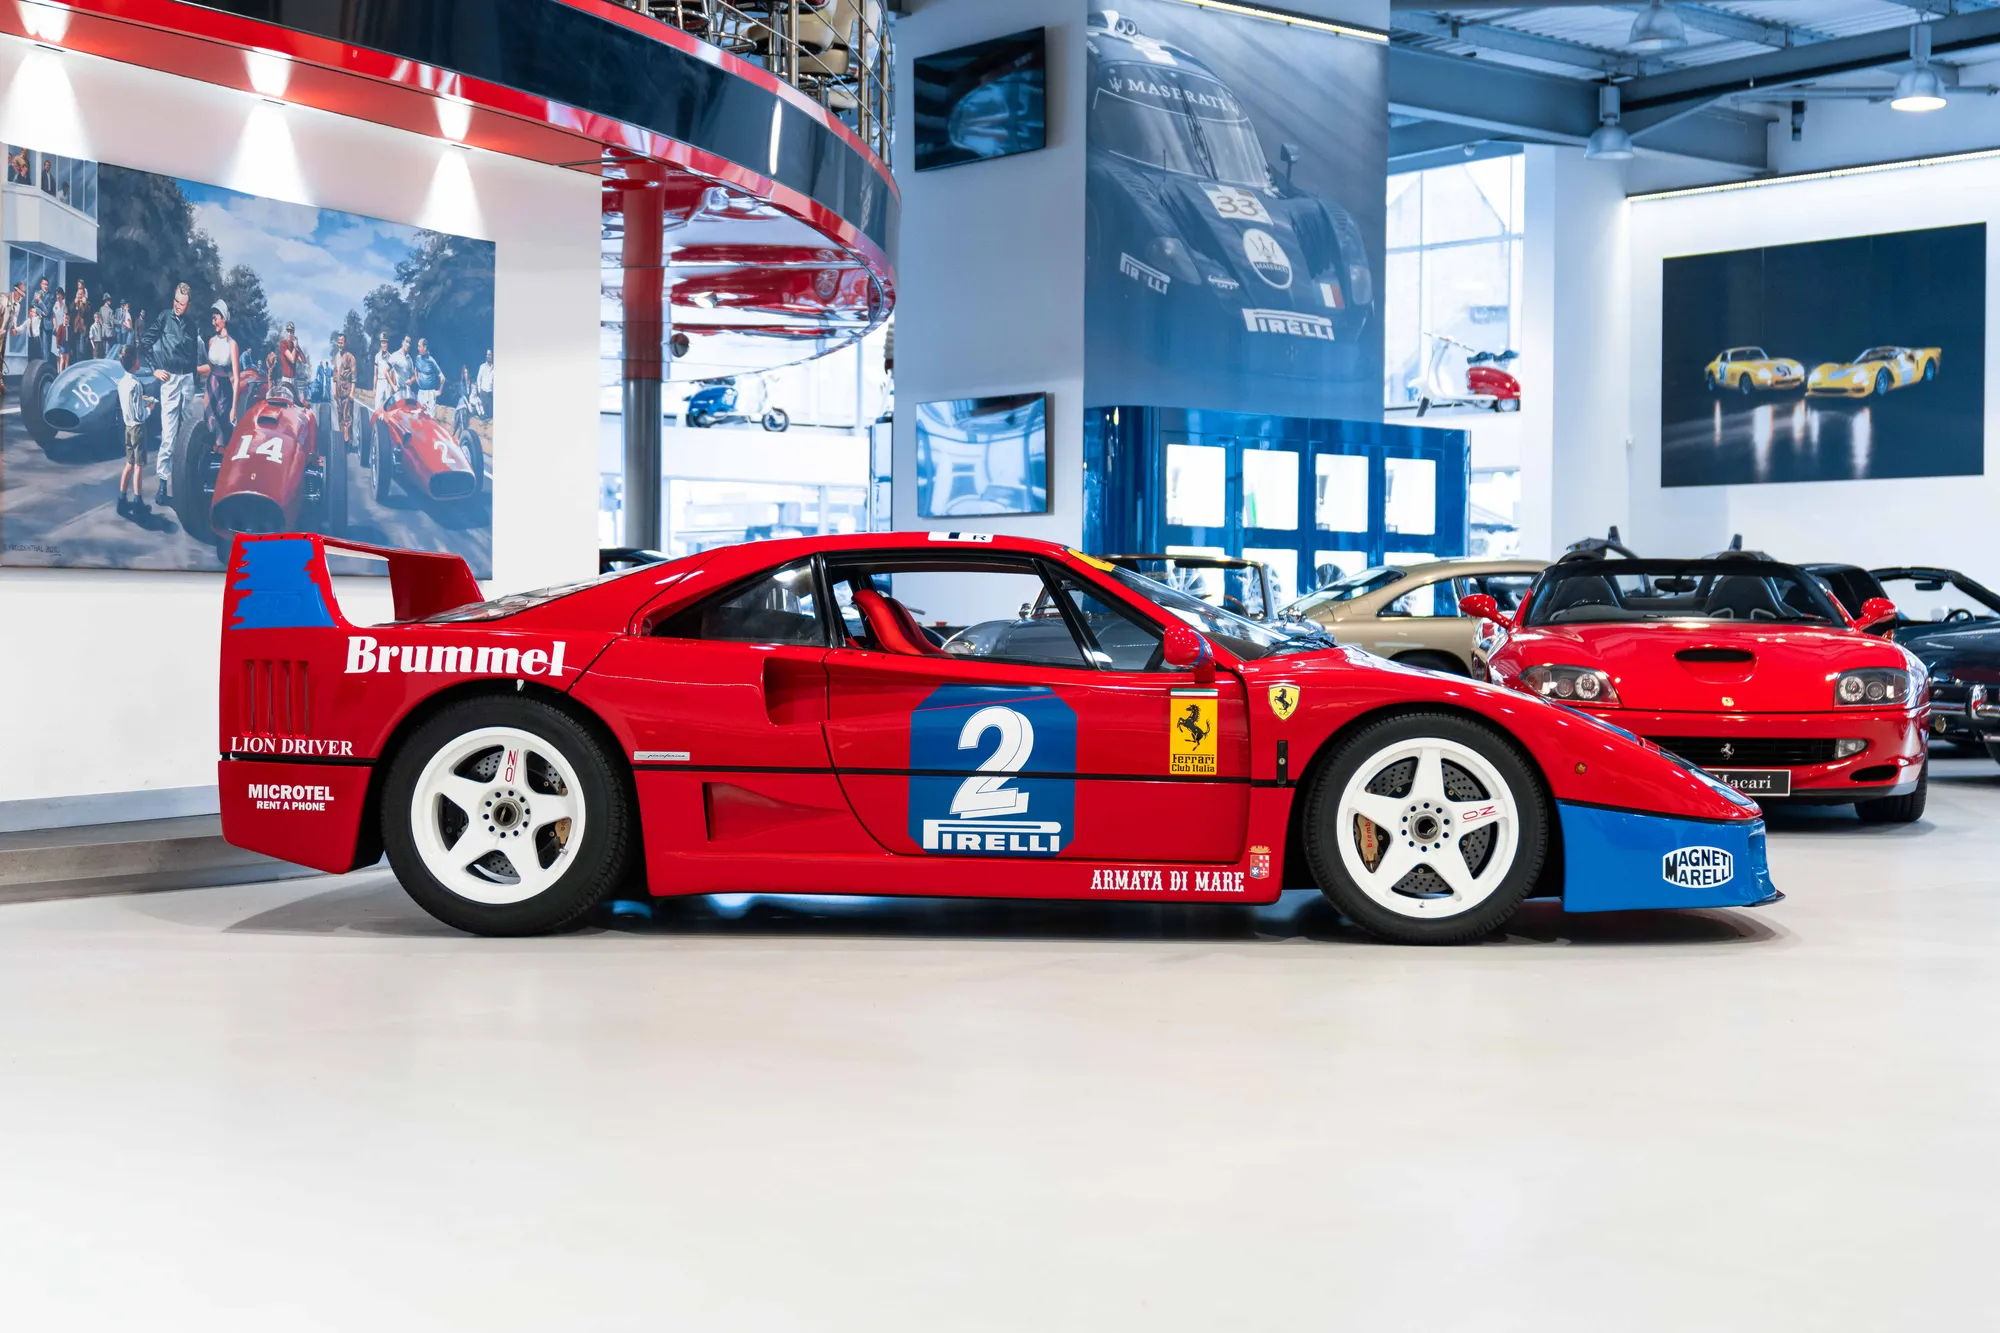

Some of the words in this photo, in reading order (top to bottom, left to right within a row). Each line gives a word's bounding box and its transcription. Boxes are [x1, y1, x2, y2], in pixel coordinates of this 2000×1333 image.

[1128, 78, 1228, 111] MASERATI
[1217, 195, 1258, 216] 33
[1119, 251, 1171, 296] PIRLLI
[1242, 308, 1335, 341] PIRELLI
[72, 383, 100, 408] 18
[231, 434, 284, 464] 14
[344, 636, 566, 677] Brummel
[231, 736, 277, 753] LION
[281, 738, 354, 756] DRIVER
[950, 705, 1034, 819] 2
[1171, 764, 1191, 772] Club
[1192, 764, 1215, 772] Italia
[1172, 754, 1215, 764] Ferrari
[248, 783, 335, 801] MICROTEL
[256, 801, 281, 810] RENT
[283, 802, 290, 810] A
[292, 802, 326, 811] PHONE
[923, 819, 1062, 852] PIRELLI
[1665, 848, 1731, 870] MAGNETI
[1090, 869, 1163, 891] ARMATA
[1169, 870, 1188, 891] DI
[1194, 871, 1245, 892] MARE
[1665, 865, 1731, 886] MARELLI
